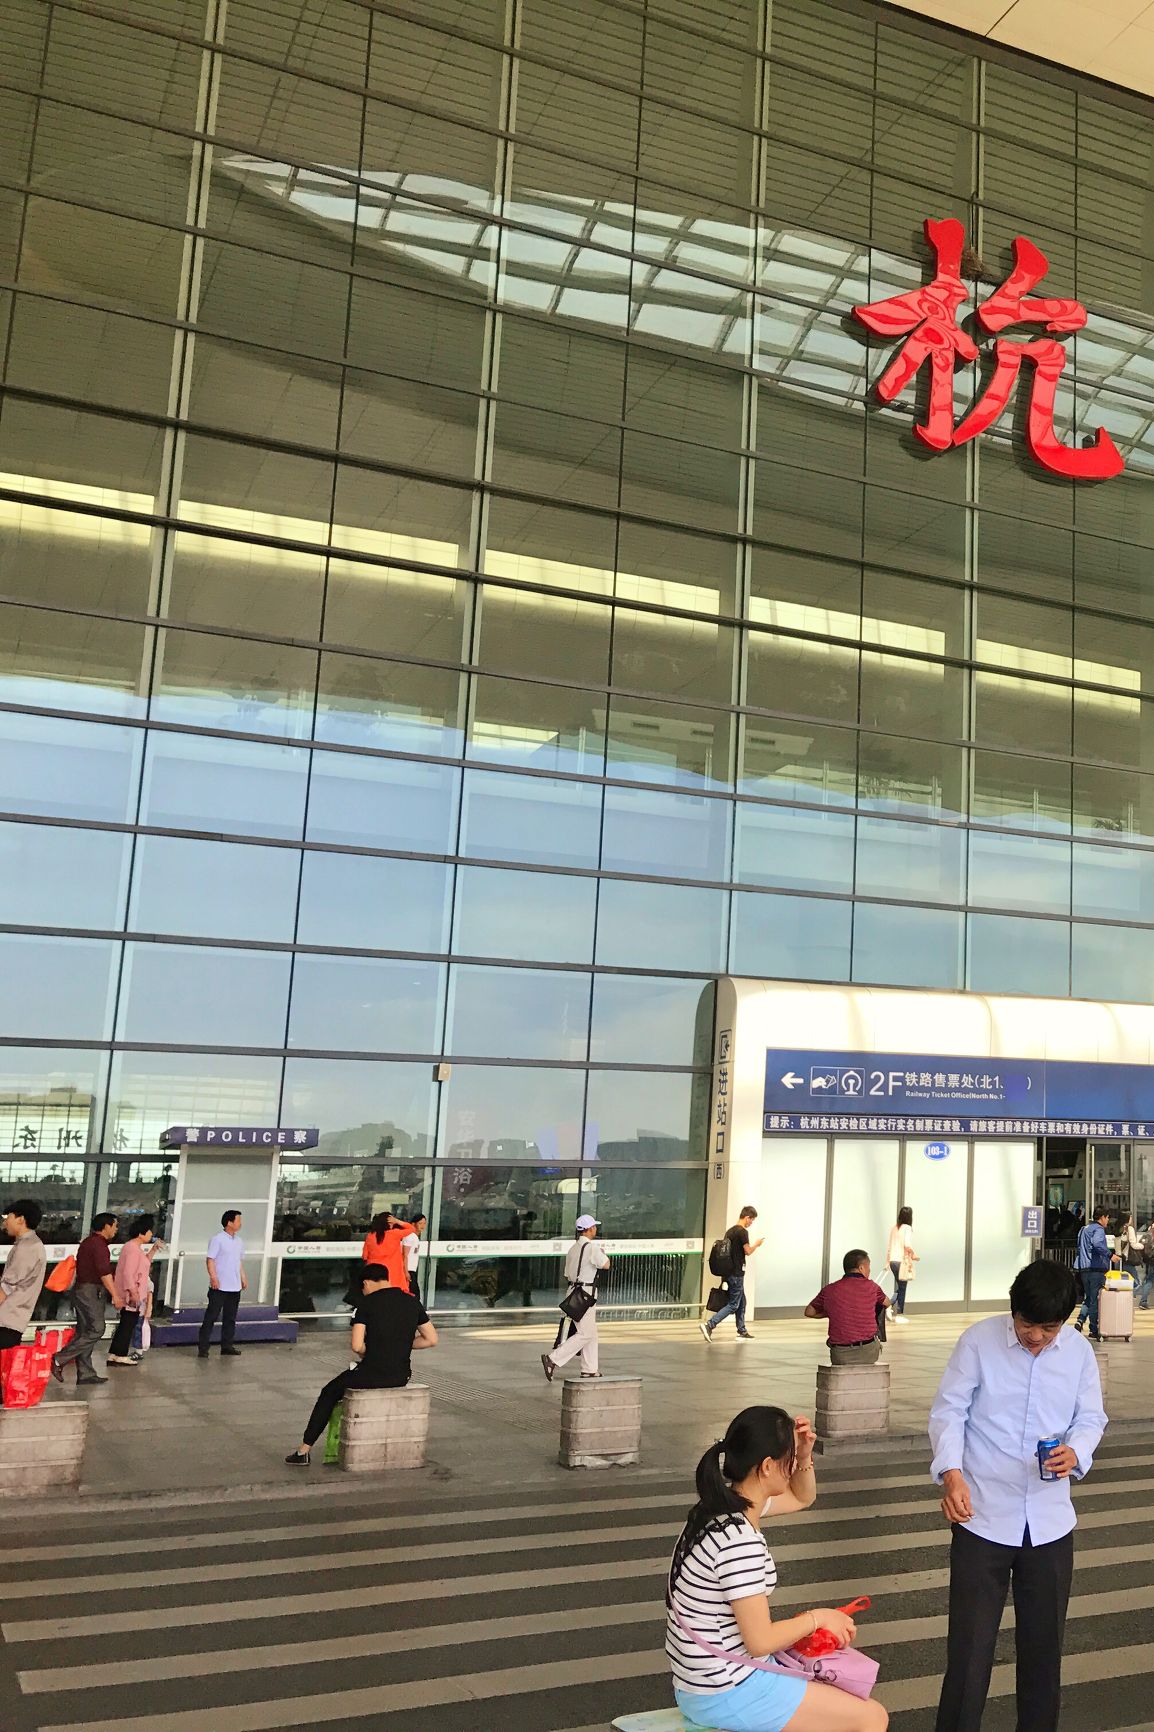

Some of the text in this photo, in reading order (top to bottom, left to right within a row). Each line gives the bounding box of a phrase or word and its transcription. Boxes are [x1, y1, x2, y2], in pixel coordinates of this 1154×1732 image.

[869, 1071, 903, 1096] 2F
[905, 1090, 930, 1099] Railway
[186, 1128, 307, 1144] 警 POLICE 察
[927, 1145, 948, 1156] 103-1
[1027, 1210, 1038, 1228] 出口
